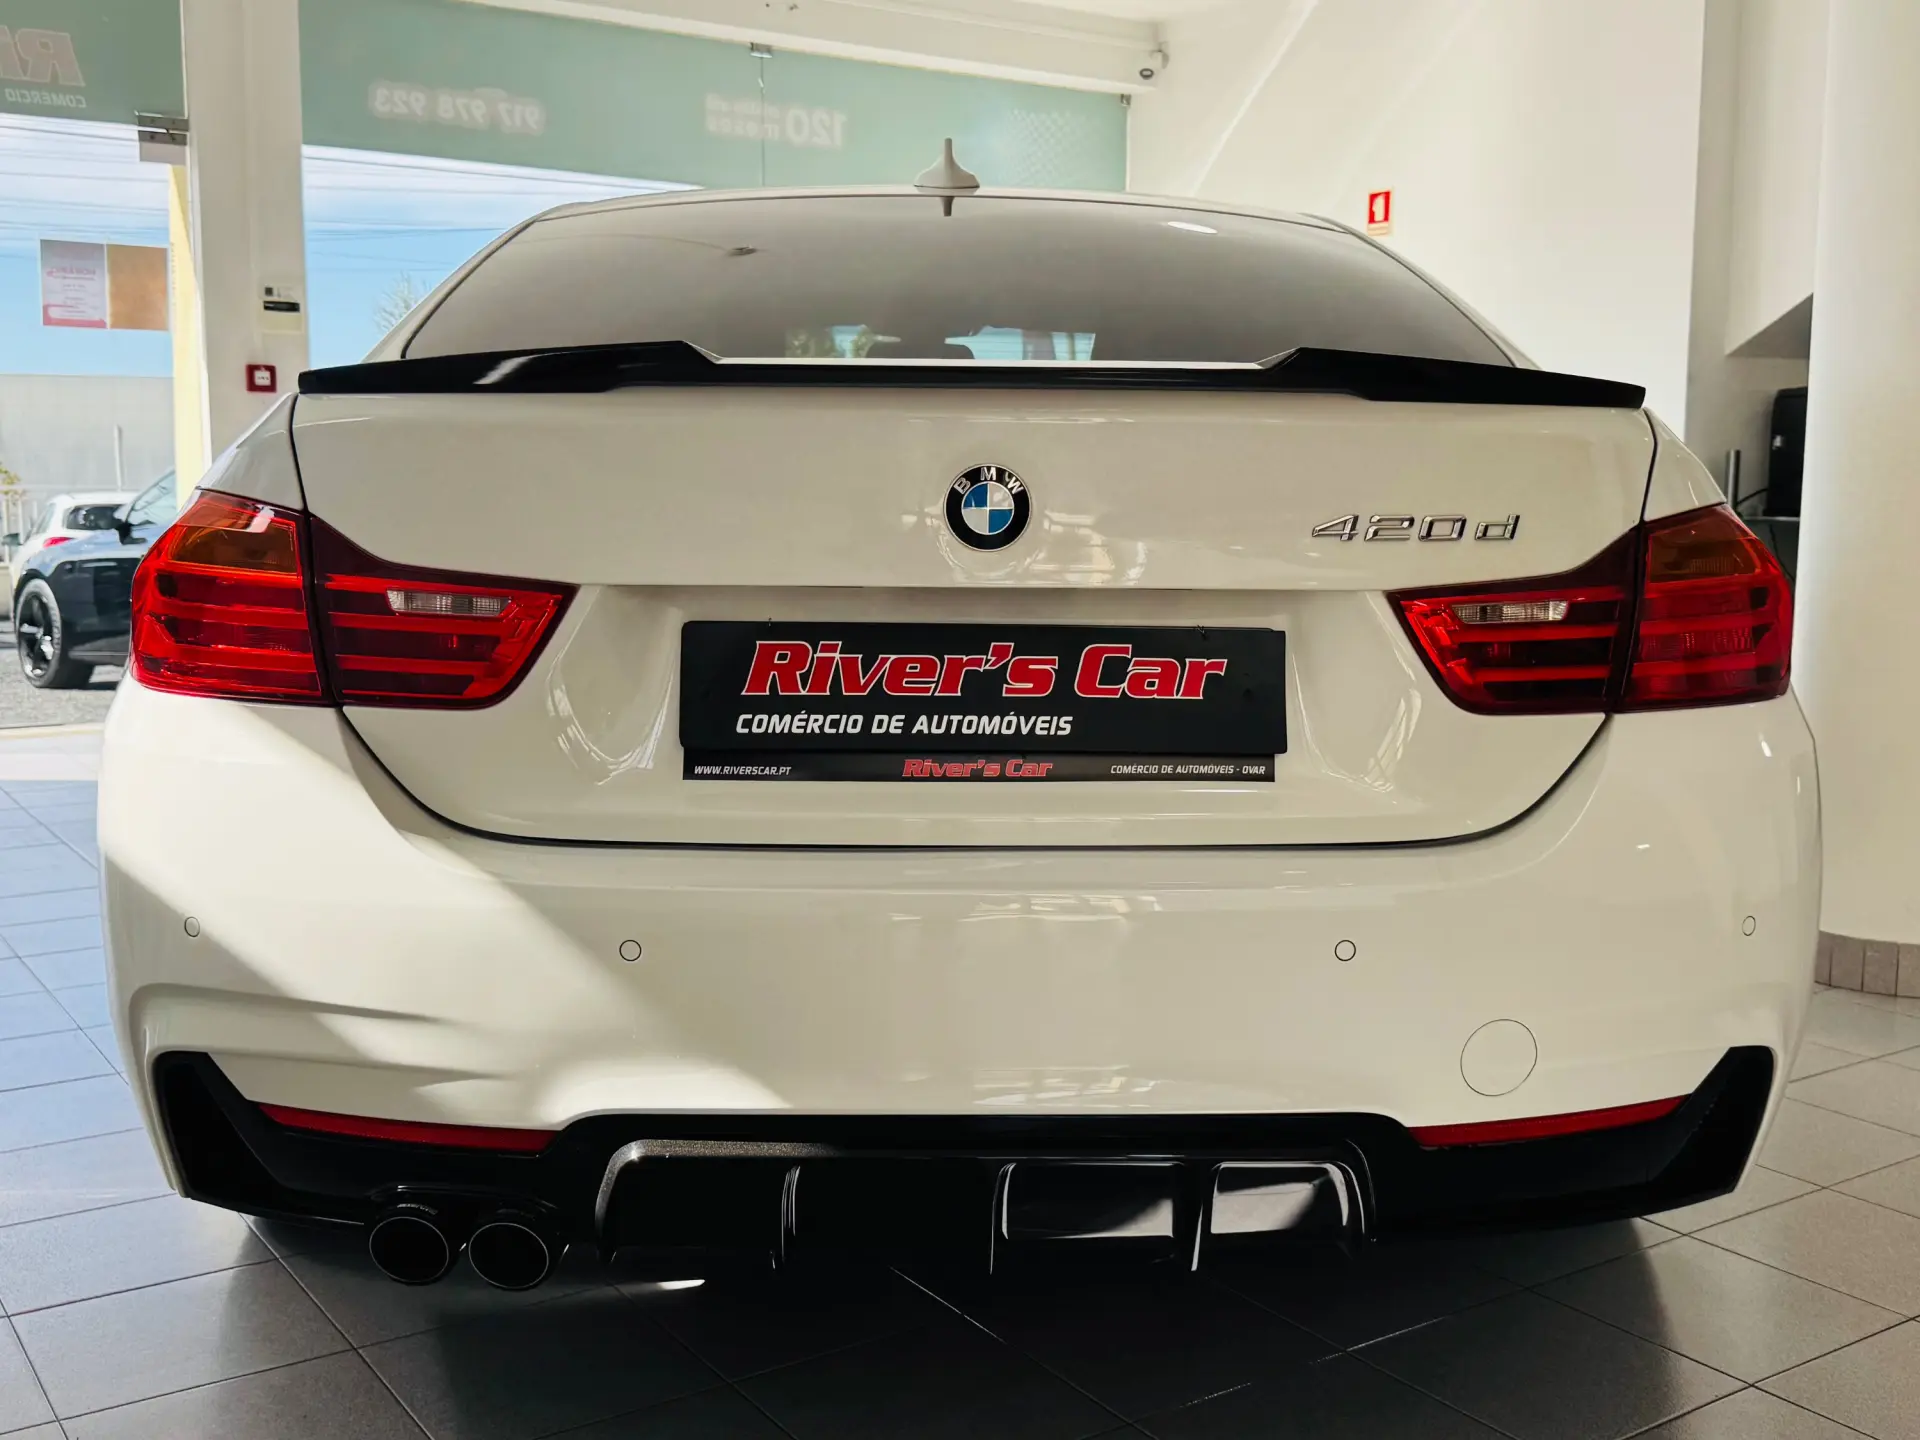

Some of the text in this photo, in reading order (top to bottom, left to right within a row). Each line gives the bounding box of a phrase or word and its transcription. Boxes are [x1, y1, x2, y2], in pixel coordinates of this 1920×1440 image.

[953, 466, 1024, 495] BMW
[1311, 514, 1520, 541] 420d
[741, 641, 1228, 699] River's Car
[735, 710, 1074, 736] COMÉRCIO DE AUTOMÓVEIS
[694, 765, 792, 776] WWW.RIVERSCAR.PT
[902, 759, 1053, 777] River's Car
[1110, 763, 1159, 774] COMÉRCIO
[1161, 765, 1174, 774] DE
[1175, 764, 1234, 774] AUTOMÓVEIS
[1242, 765, 1266, 775] OVAR
